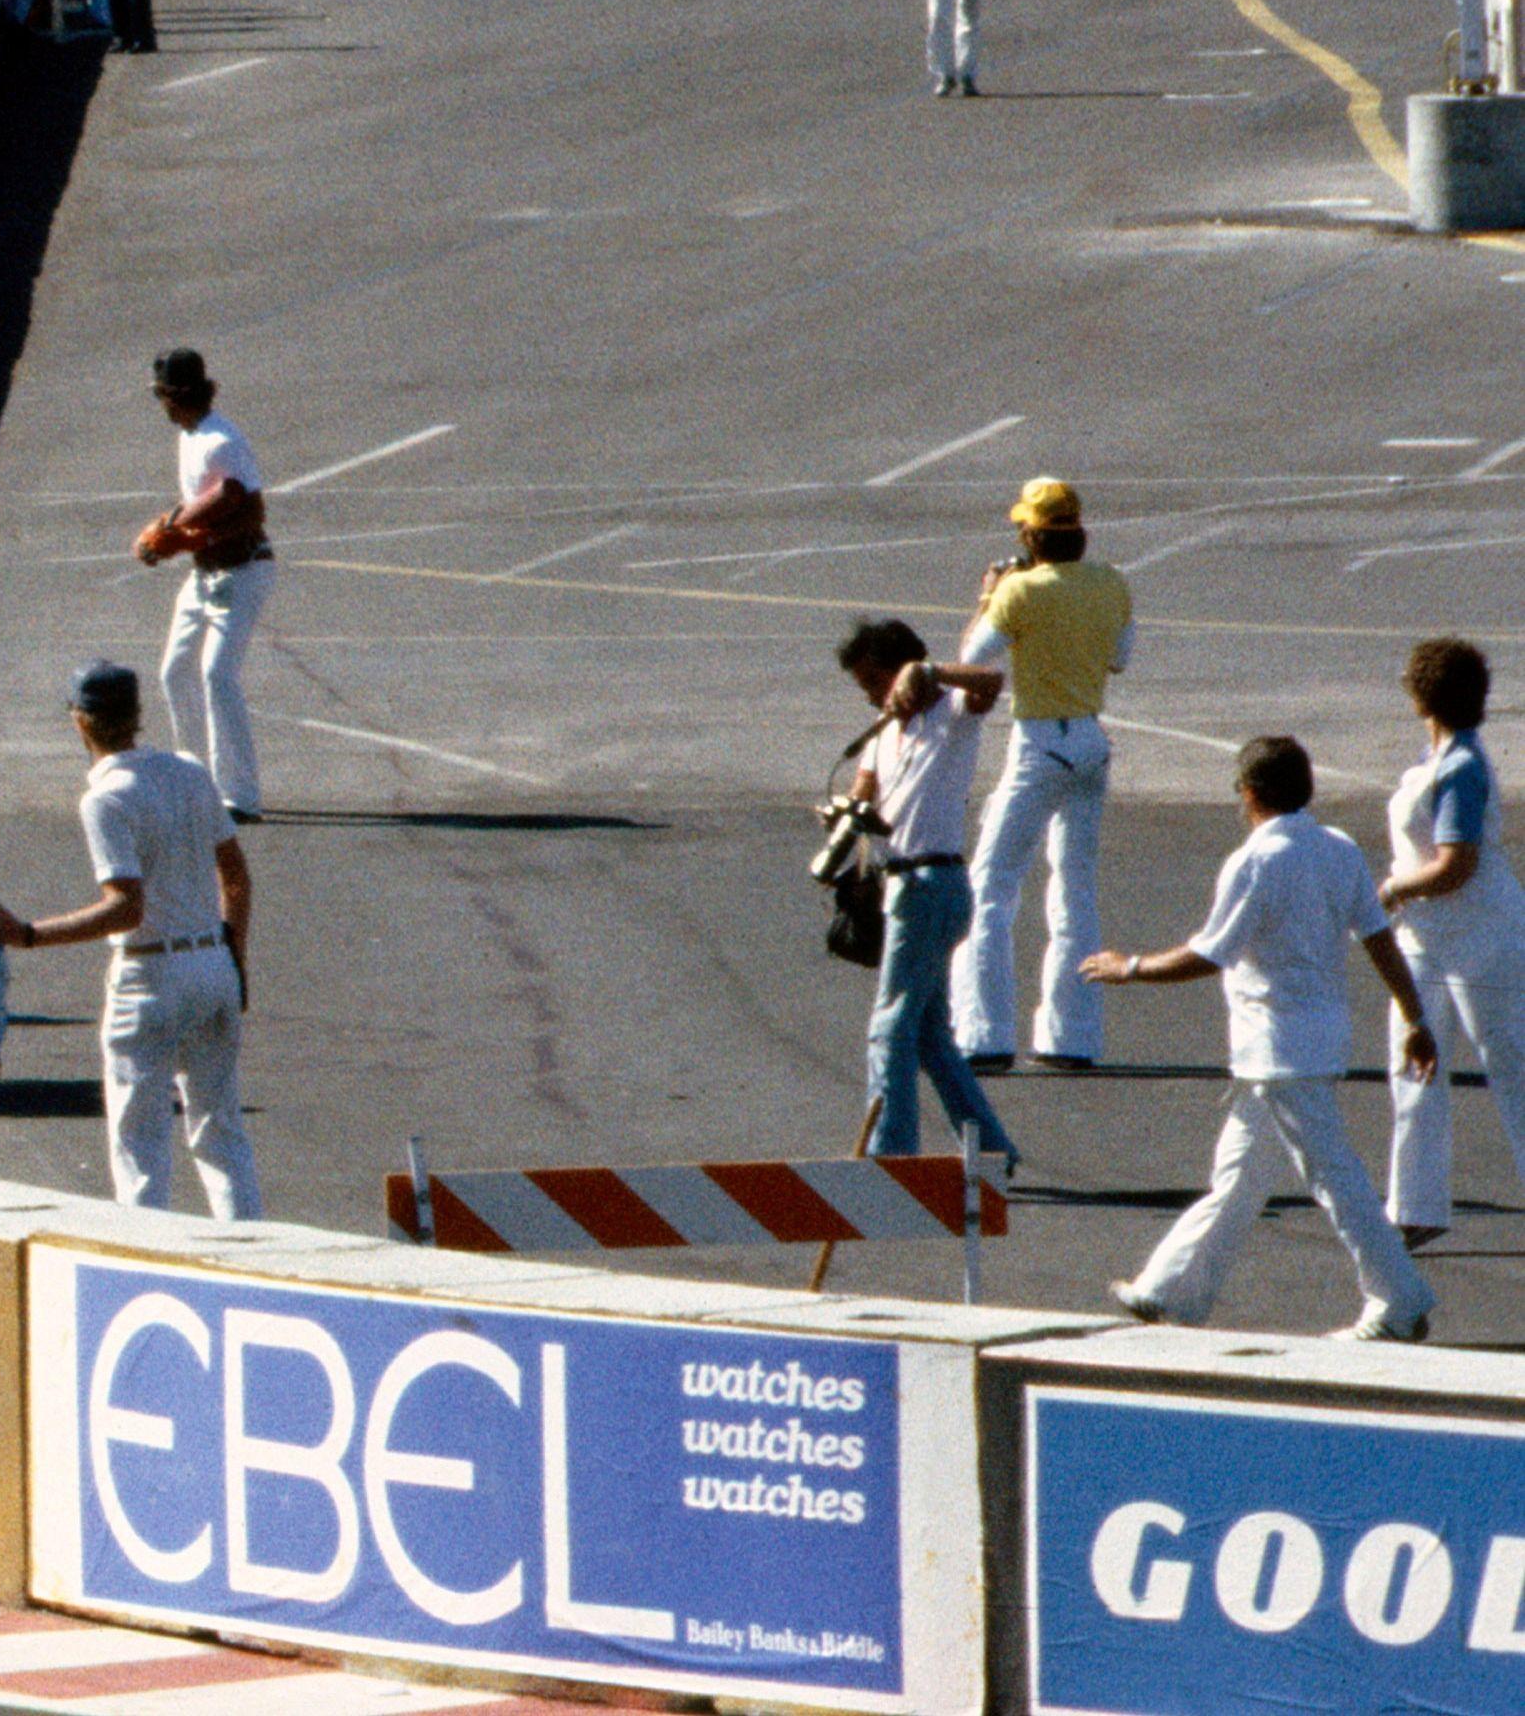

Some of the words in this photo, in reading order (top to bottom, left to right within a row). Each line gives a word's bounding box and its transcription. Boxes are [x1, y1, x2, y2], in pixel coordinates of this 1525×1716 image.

[681, 1359, 866, 1412] watches
[88, 1292, 676, 1643] EBEL
[681, 1417, 866, 1470] watches
[682, 1473, 867, 1524] watches
[686, 1617, 745, 1653] Bailey
